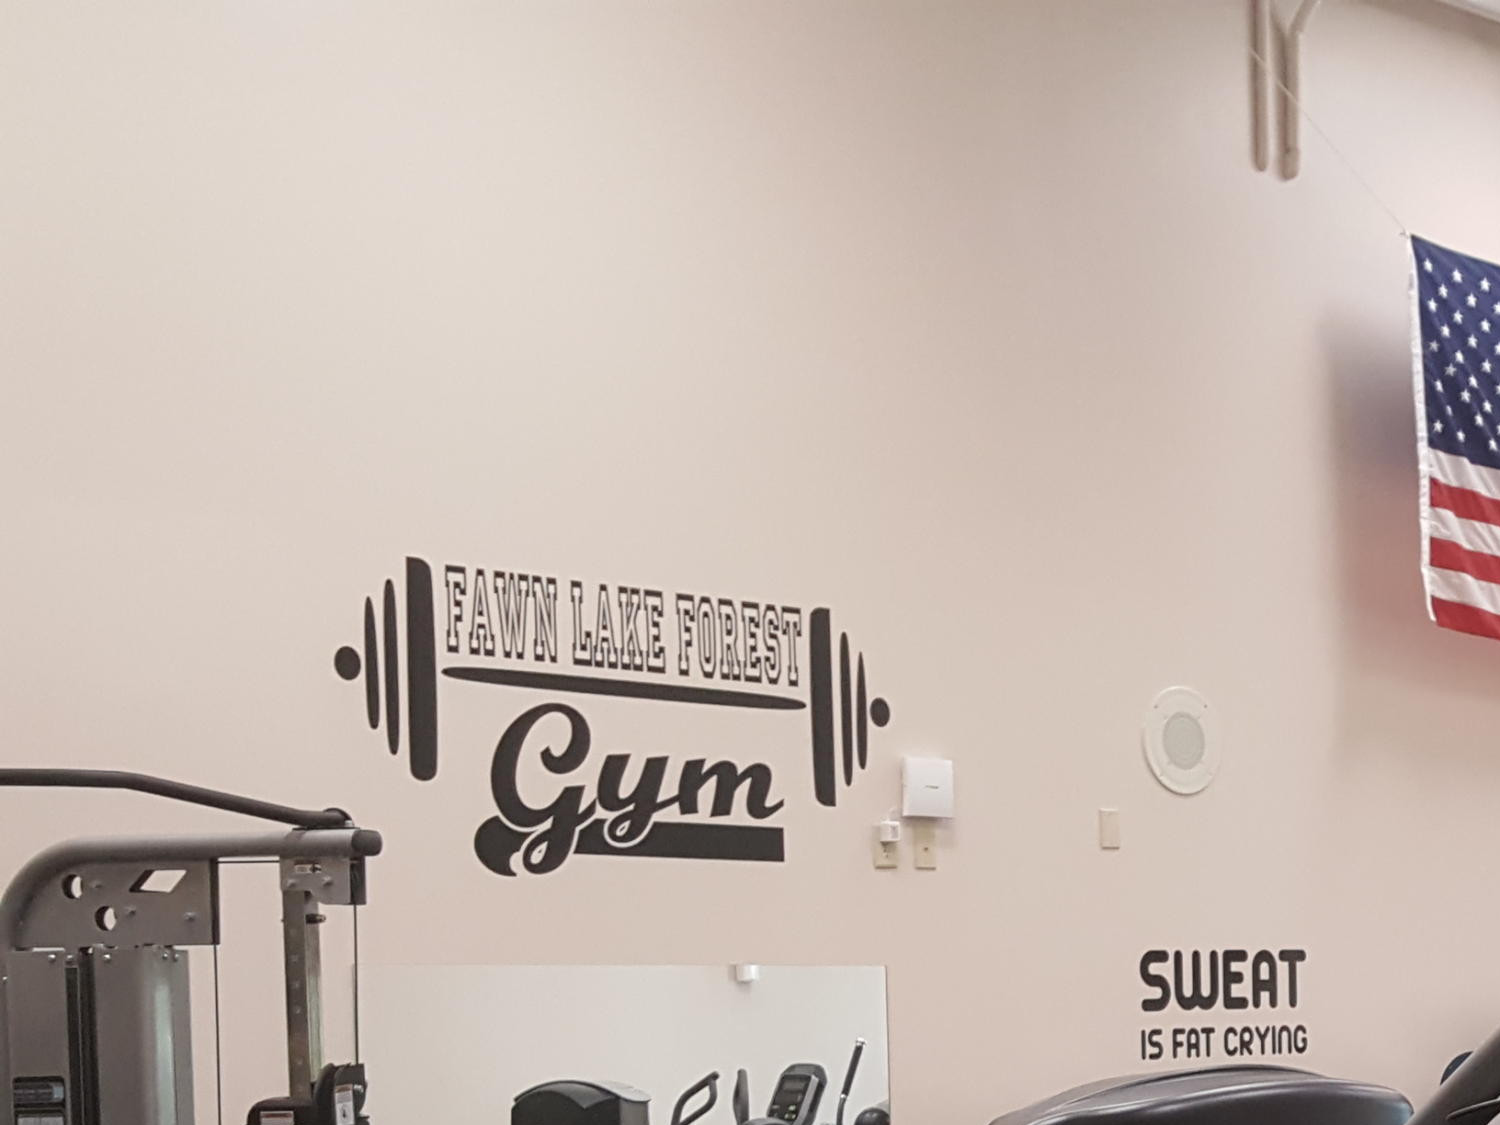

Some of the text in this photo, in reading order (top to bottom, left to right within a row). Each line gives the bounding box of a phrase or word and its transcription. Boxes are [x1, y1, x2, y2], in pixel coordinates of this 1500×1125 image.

[444, 564, 802, 687] FAWN LAKE FOREST
[491, 702, 785, 875] Gym
[1140, 949, 1307, 1012] SWEAT
[1141, 1025, 1308, 1060] IS FAT CRYING
